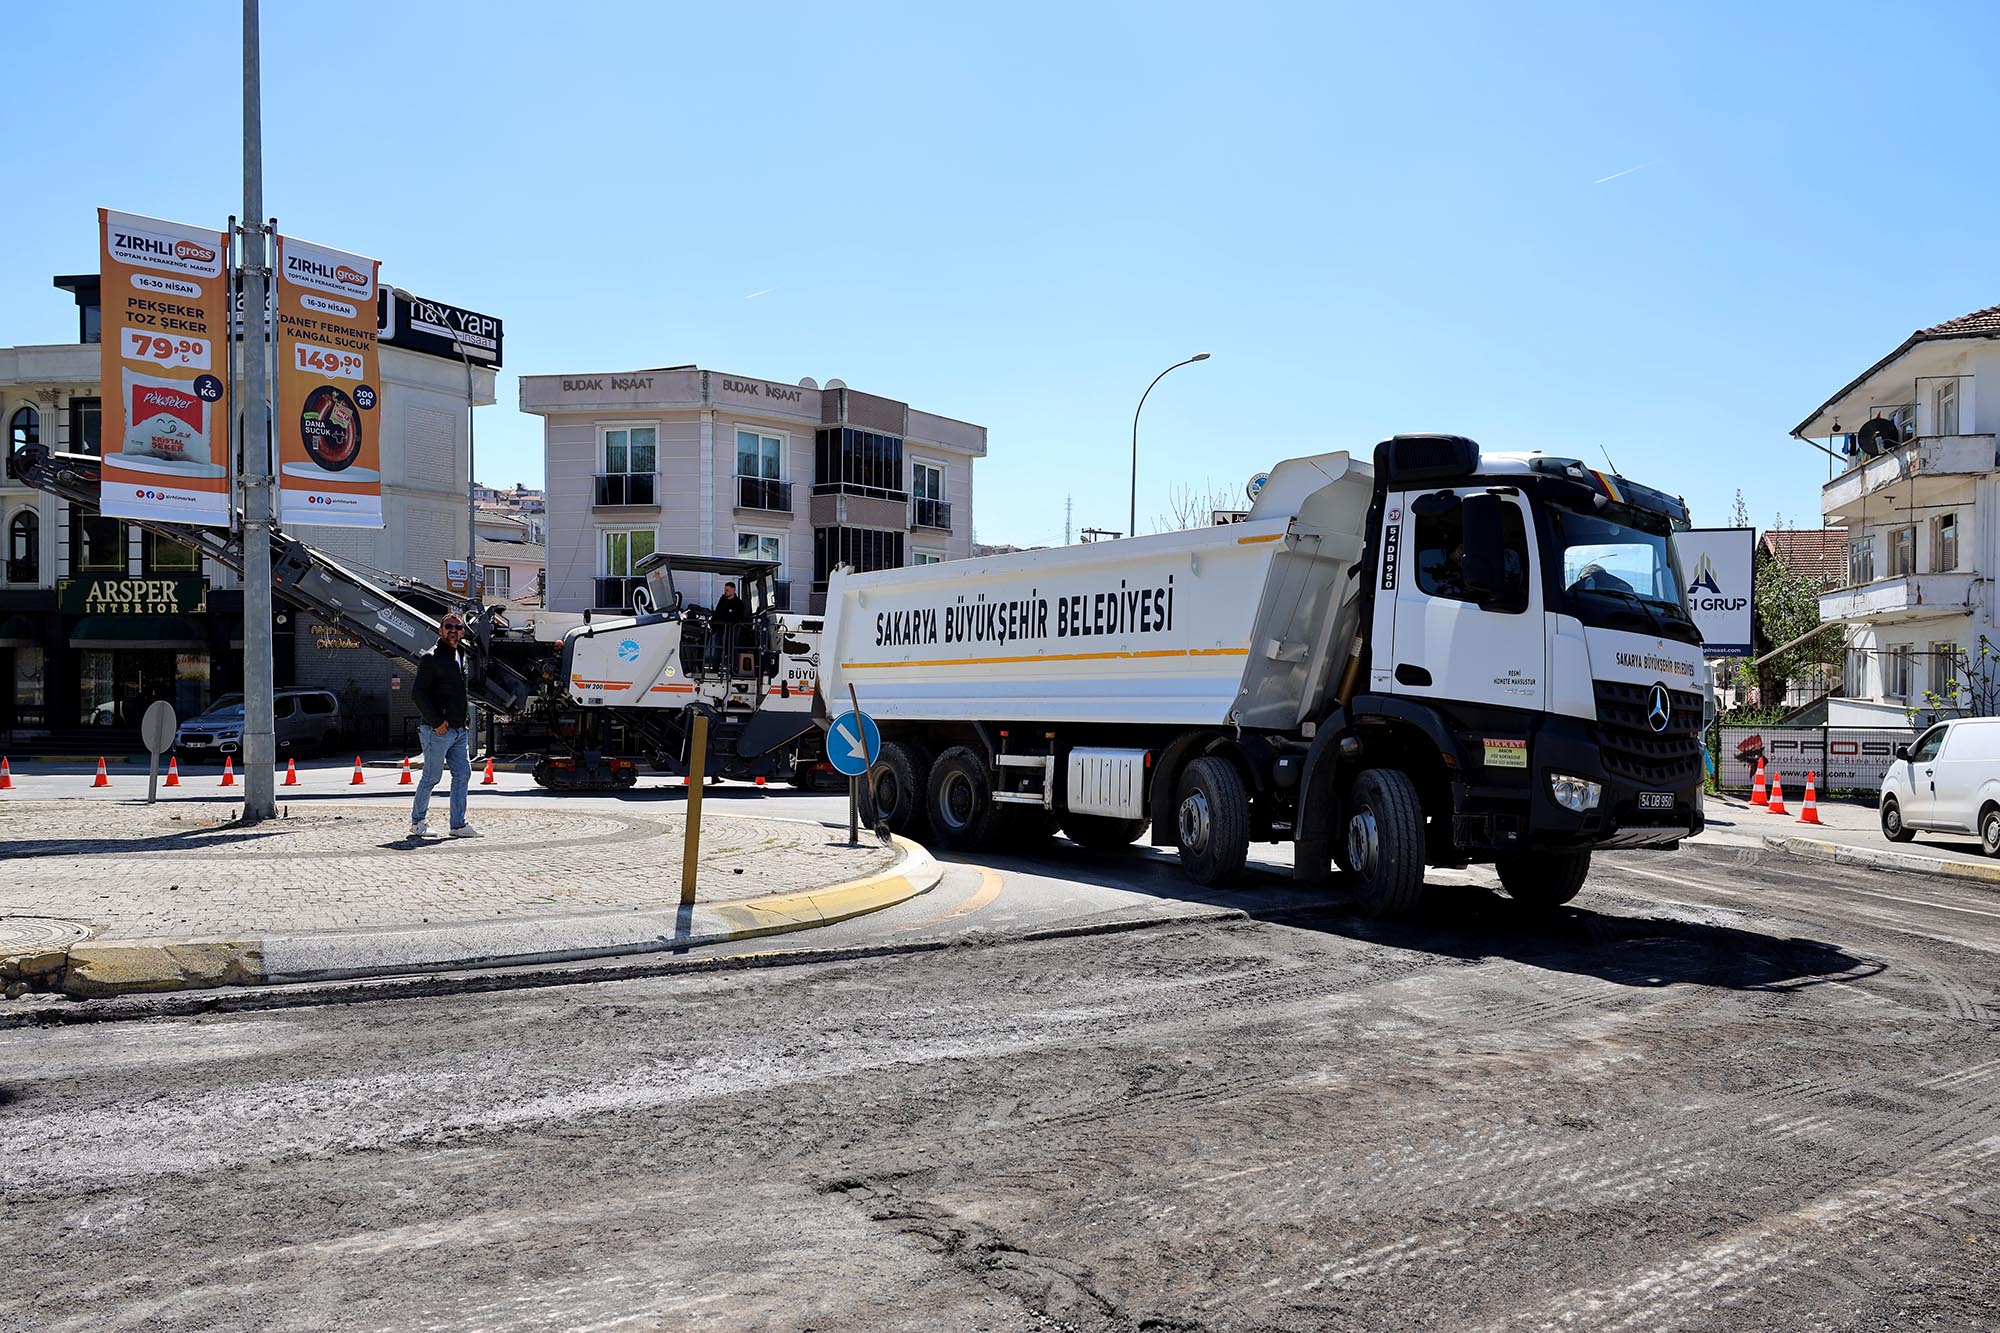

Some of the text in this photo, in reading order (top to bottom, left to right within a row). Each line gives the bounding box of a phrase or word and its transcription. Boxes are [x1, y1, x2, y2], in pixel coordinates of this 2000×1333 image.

[114, 233, 212, 260] ZIRHLI gross
[115, 250, 142, 260] TOPTAN
[149, 256, 188, 268] PERAKENDE
[189, 264, 216, 273] MARKET
[287, 255, 366, 284] ZIRHLI gross
[139, 278, 193, 294] 16-30 NİSAN
[288, 272, 310, 282] TOPTAN
[315, 278, 346, 291] PERAKENDE
[347, 287, 368, 296] MARKET
[127, 297, 205, 319] PEKŞEKER
[307, 299, 351, 314] 16-30 NİSAN
[125, 311, 207, 334] TOZ ŞEKER
[280, 314, 318, 329] DANET
[320, 322, 376, 341] FERMENTE
[131, 333, 203, 360] 79,90
[287, 327, 370, 351] KANGAL SUCUK
[297, 348, 362, 372] 149,90
[205, 380, 212, 389] 2
[562, 376, 654, 392] BUDAK İNŞAAT
[722, 379, 803, 402] BUDAK İNŞAAT
[201, 388, 216, 398] KG
[356, 389, 374, 399] 200
[359, 397, 372, 407] GR
[305, 420, 326, 429] DANA
[305, 427, 331, 436] SUCUK
[1390, 511, 1400, 520] 39
[85, 580, 179, 602] ARSPER
[85, 603, 179, 613] INTERIOR
[875, 574, 1175, 646] SAKARYA BÜYÜKŞEHİR BELEDİYESİ
[1701, 598, 1747, 611] GRUP
[1615, 651, 1695, 677] SAKARYA BÜYÜKŞEHİR BELEDİYESİ
[788, 667, 815, 680] BÜYÜ
[1771, 740, 1914, 756] PROSI
[1771, 754, 1839, 765] Profesyoel
[1641, 794, 1673, 807] 54 DB 950
